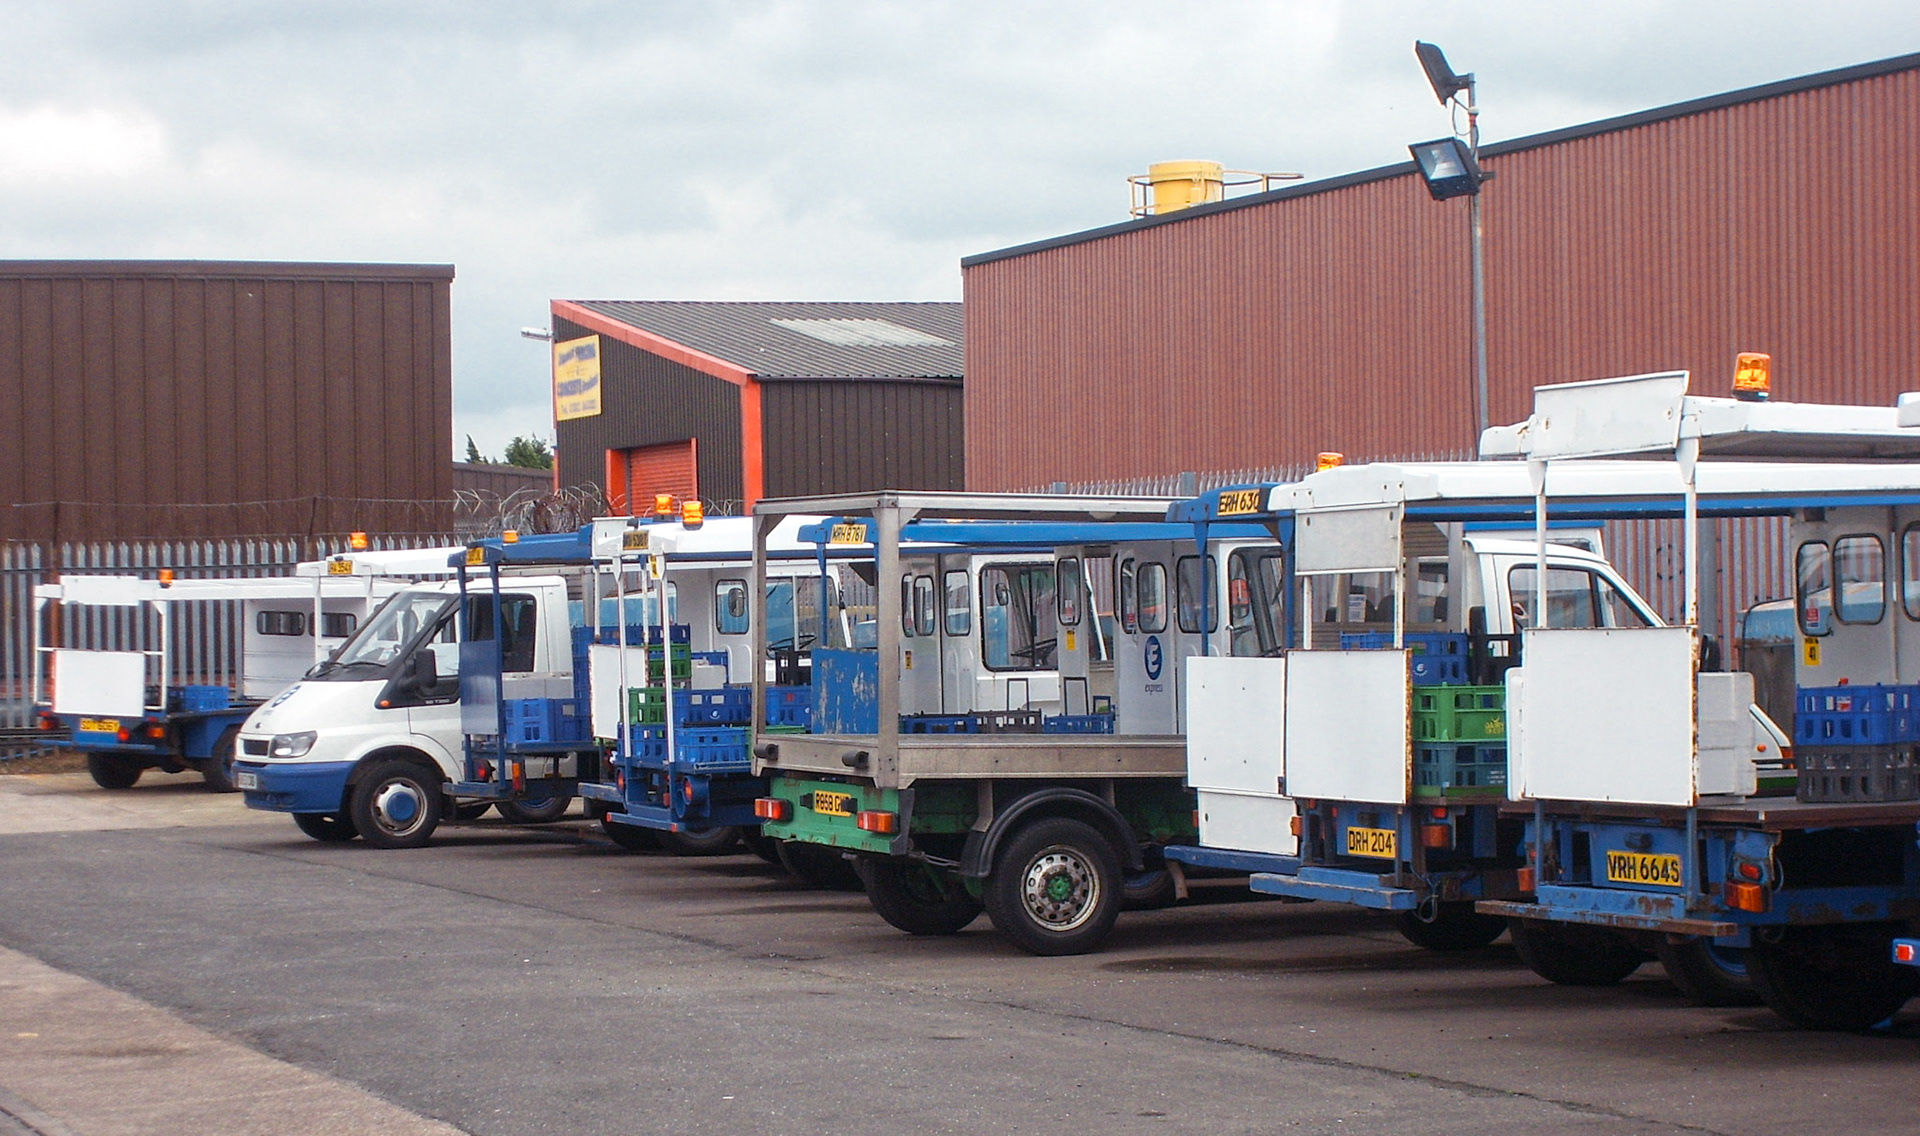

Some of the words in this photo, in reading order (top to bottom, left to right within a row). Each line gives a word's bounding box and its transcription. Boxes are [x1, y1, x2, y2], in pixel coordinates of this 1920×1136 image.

[1219, 493, 1239, 513] ERH
[1145, 684, 1163, 695] express
[816, 792, 834, 811] R858
[1349, 830, 1369, 852] DRH
[1608, 855, 1637, 880] VRH
[1640, 857, 1680, 883] 664S
